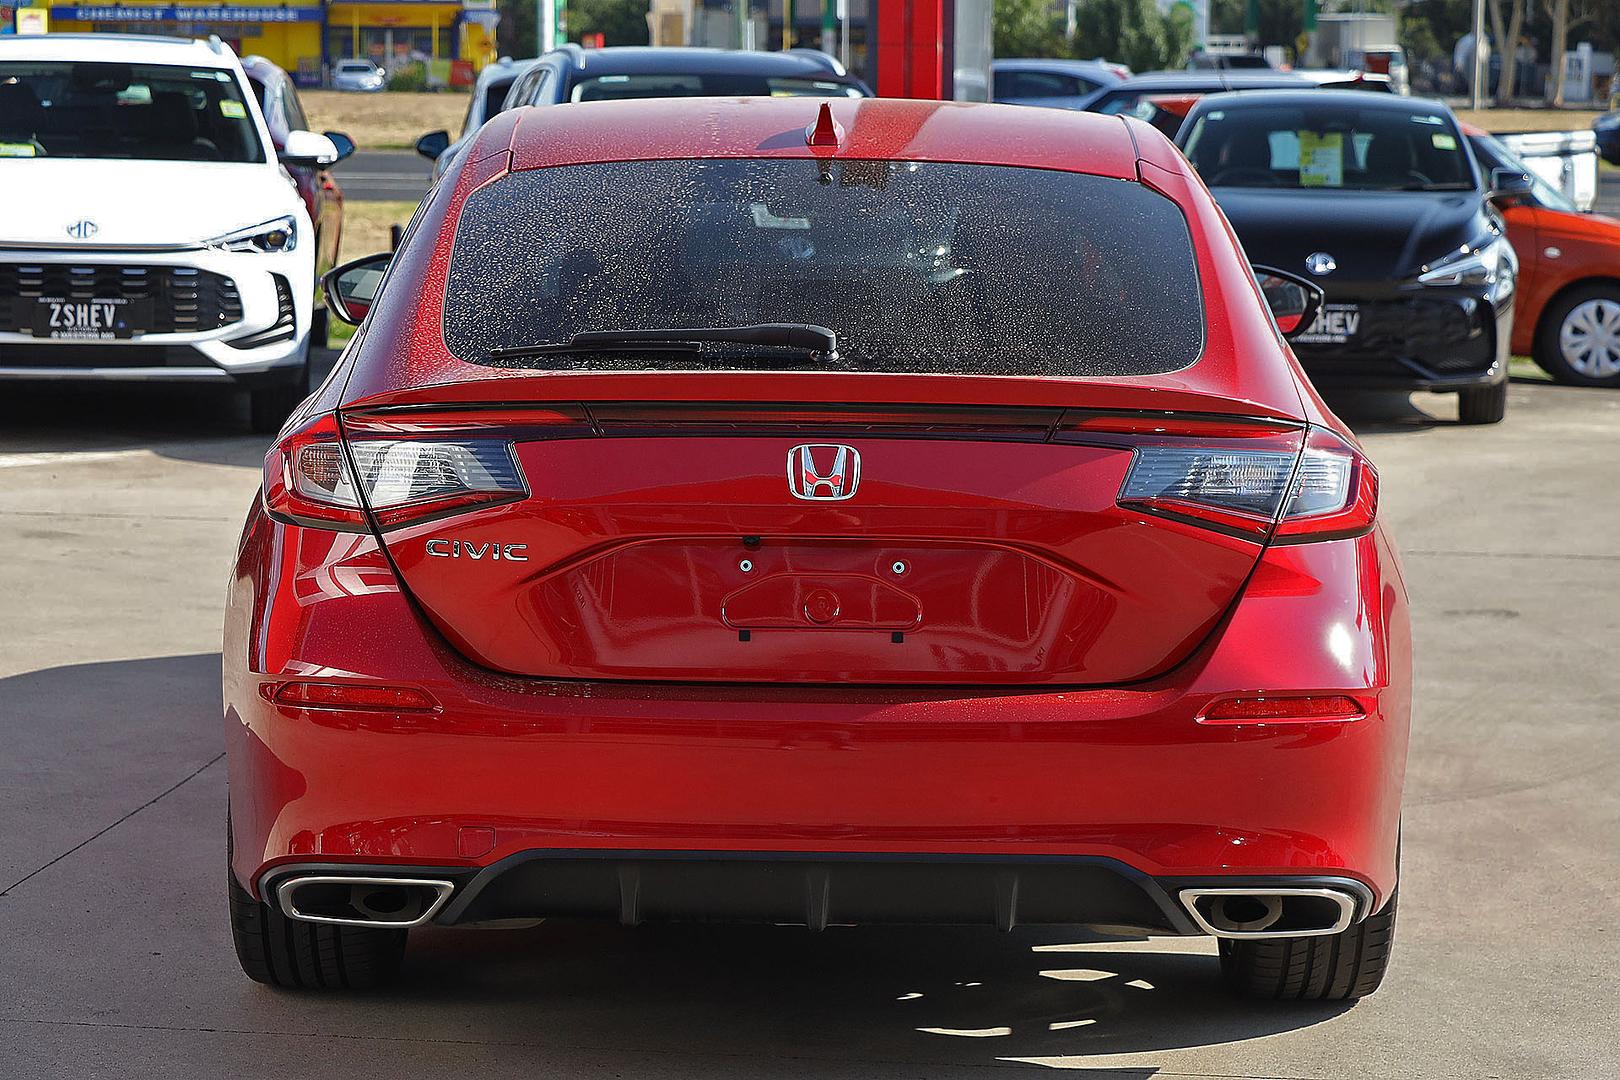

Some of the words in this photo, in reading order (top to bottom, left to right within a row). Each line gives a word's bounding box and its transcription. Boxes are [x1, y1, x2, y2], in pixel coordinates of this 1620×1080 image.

[76, 8, 163, 21] CHEMIST
[175, 8, 298, 21] WAREHOUSE
[49, 303, 115, 328] ZSHEV
[425, 539, 528, 561] CIVIC
